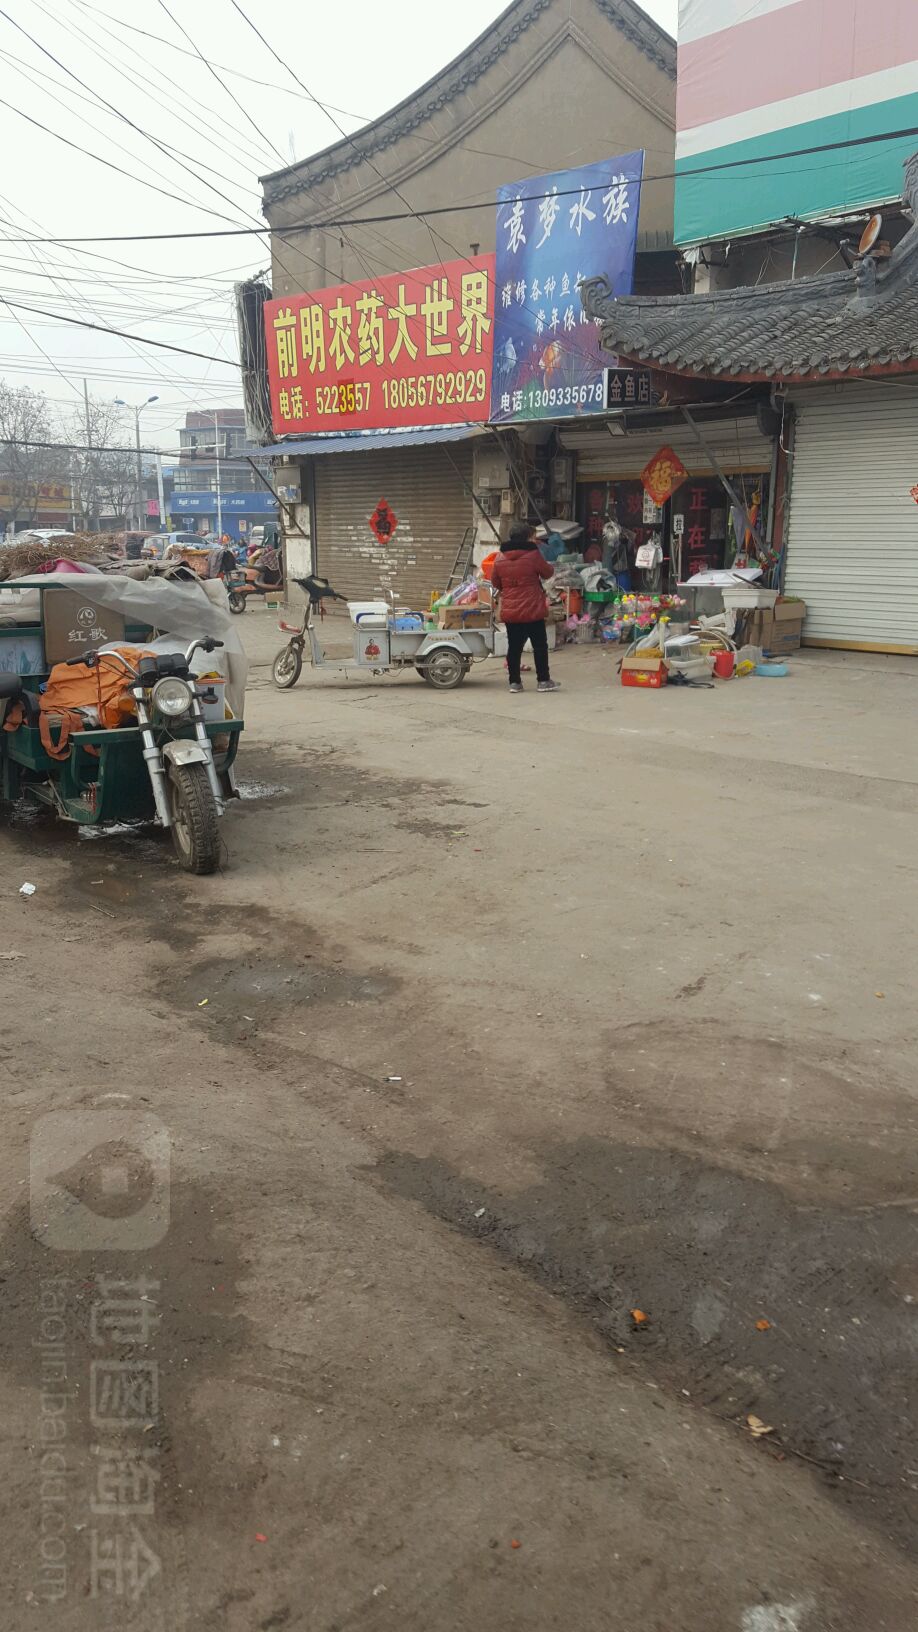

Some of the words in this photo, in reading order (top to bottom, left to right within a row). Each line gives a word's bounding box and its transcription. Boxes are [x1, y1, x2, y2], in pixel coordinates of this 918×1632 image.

[503, 173, 630, 254] 袁梦水族
[274, 269, 492, 378] 前明农药大世界
[382, 368, 486, 409] 18056792929
[611, 373, 649, 402] 金鱼店
[68, 627, 108, 642] 红歌
